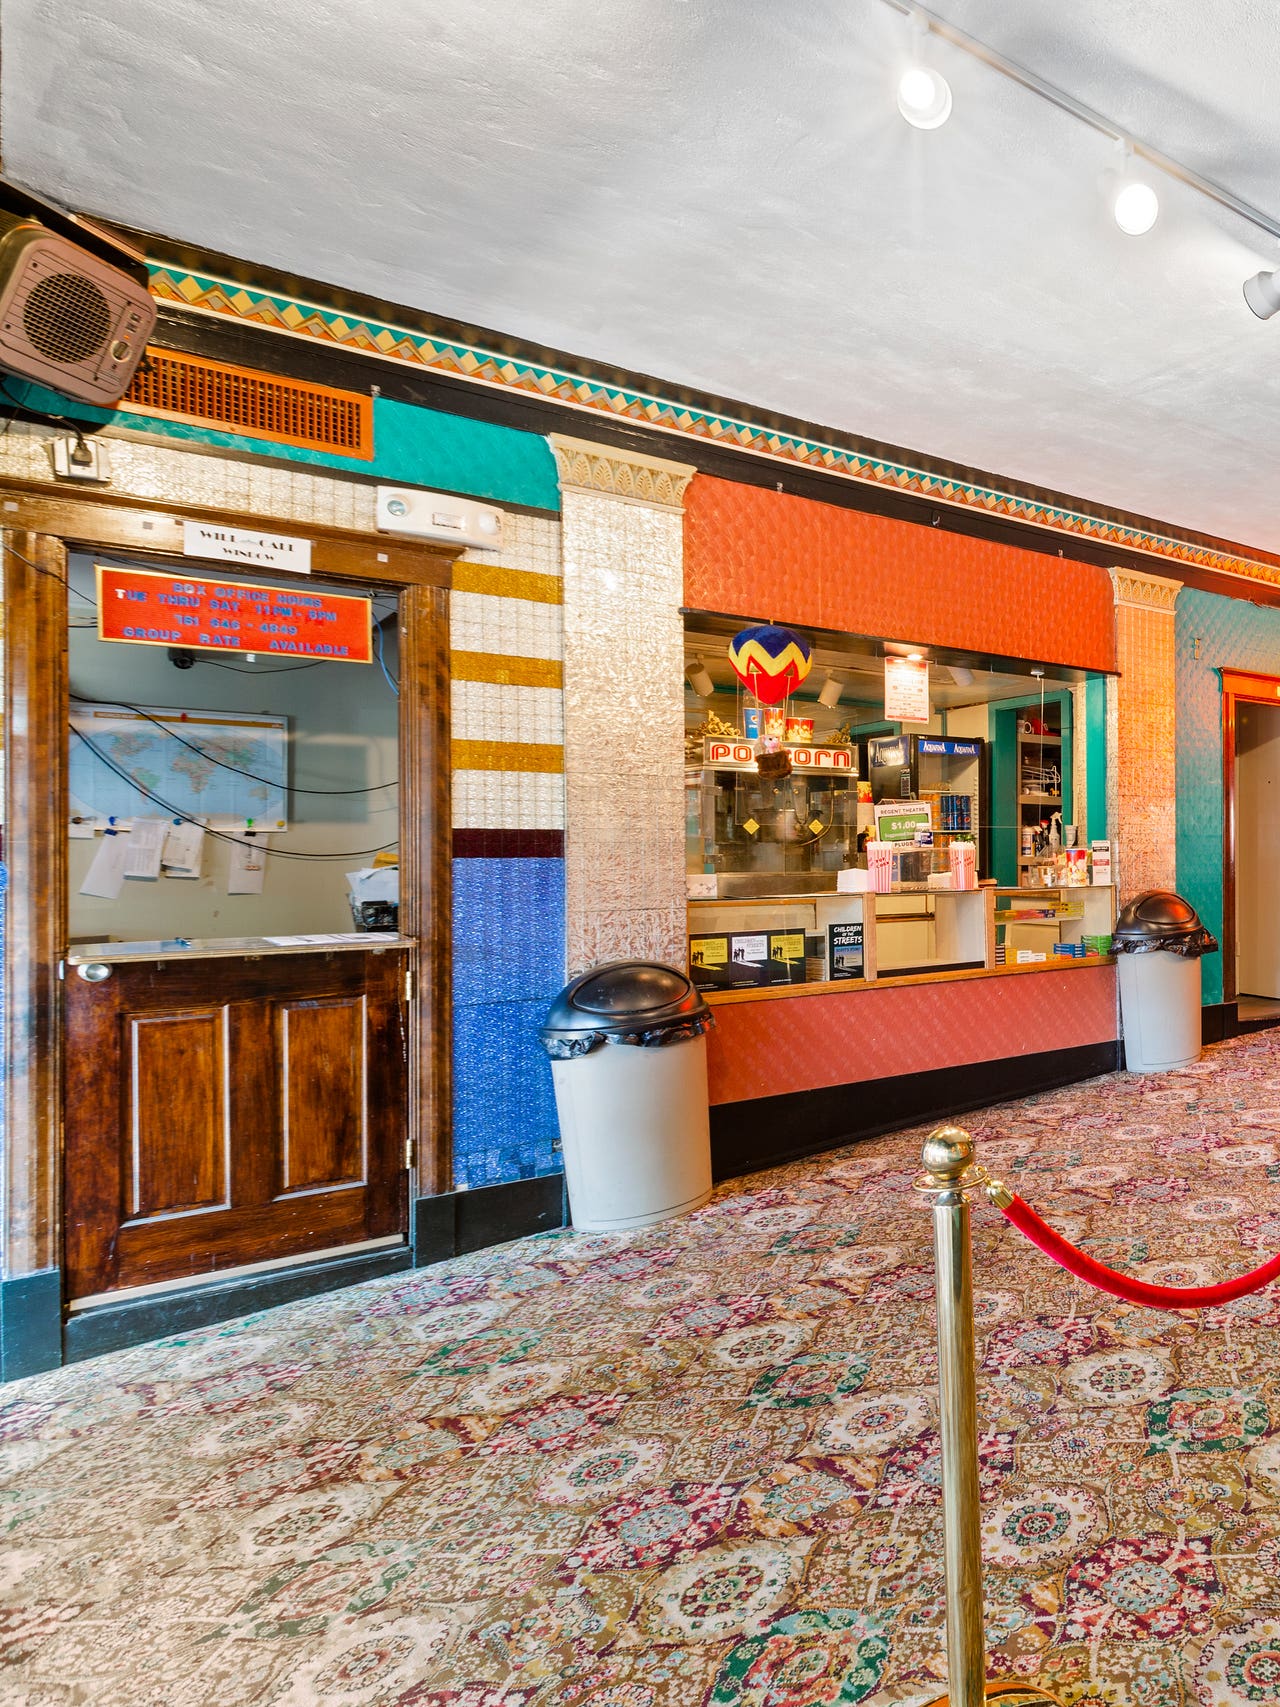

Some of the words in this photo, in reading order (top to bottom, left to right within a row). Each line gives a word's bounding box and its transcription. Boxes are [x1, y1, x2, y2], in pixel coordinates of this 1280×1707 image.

[200, 530, 237, 542] WILL
[259, 540, 295, 552] CALL
[223, 547, 275, 560] WINDOW
[115, 588, 147, 602] TUE
[157, 593, 200, 607] THRU
[210, 599, 240, 612] SAT
[173, 582, 206, 596] BOX
[214, 587, 269, 602] OFFICE
[277, 594, 322, 608] HOURS
[123, 627, 181, 641] GROUP
[200, 633, 240, 647] RATE
[269, 640, 349, 656] AVAILABLE
[891, 820, 916, 830] $1.00
[833, 935, 863, 945] STREETS
